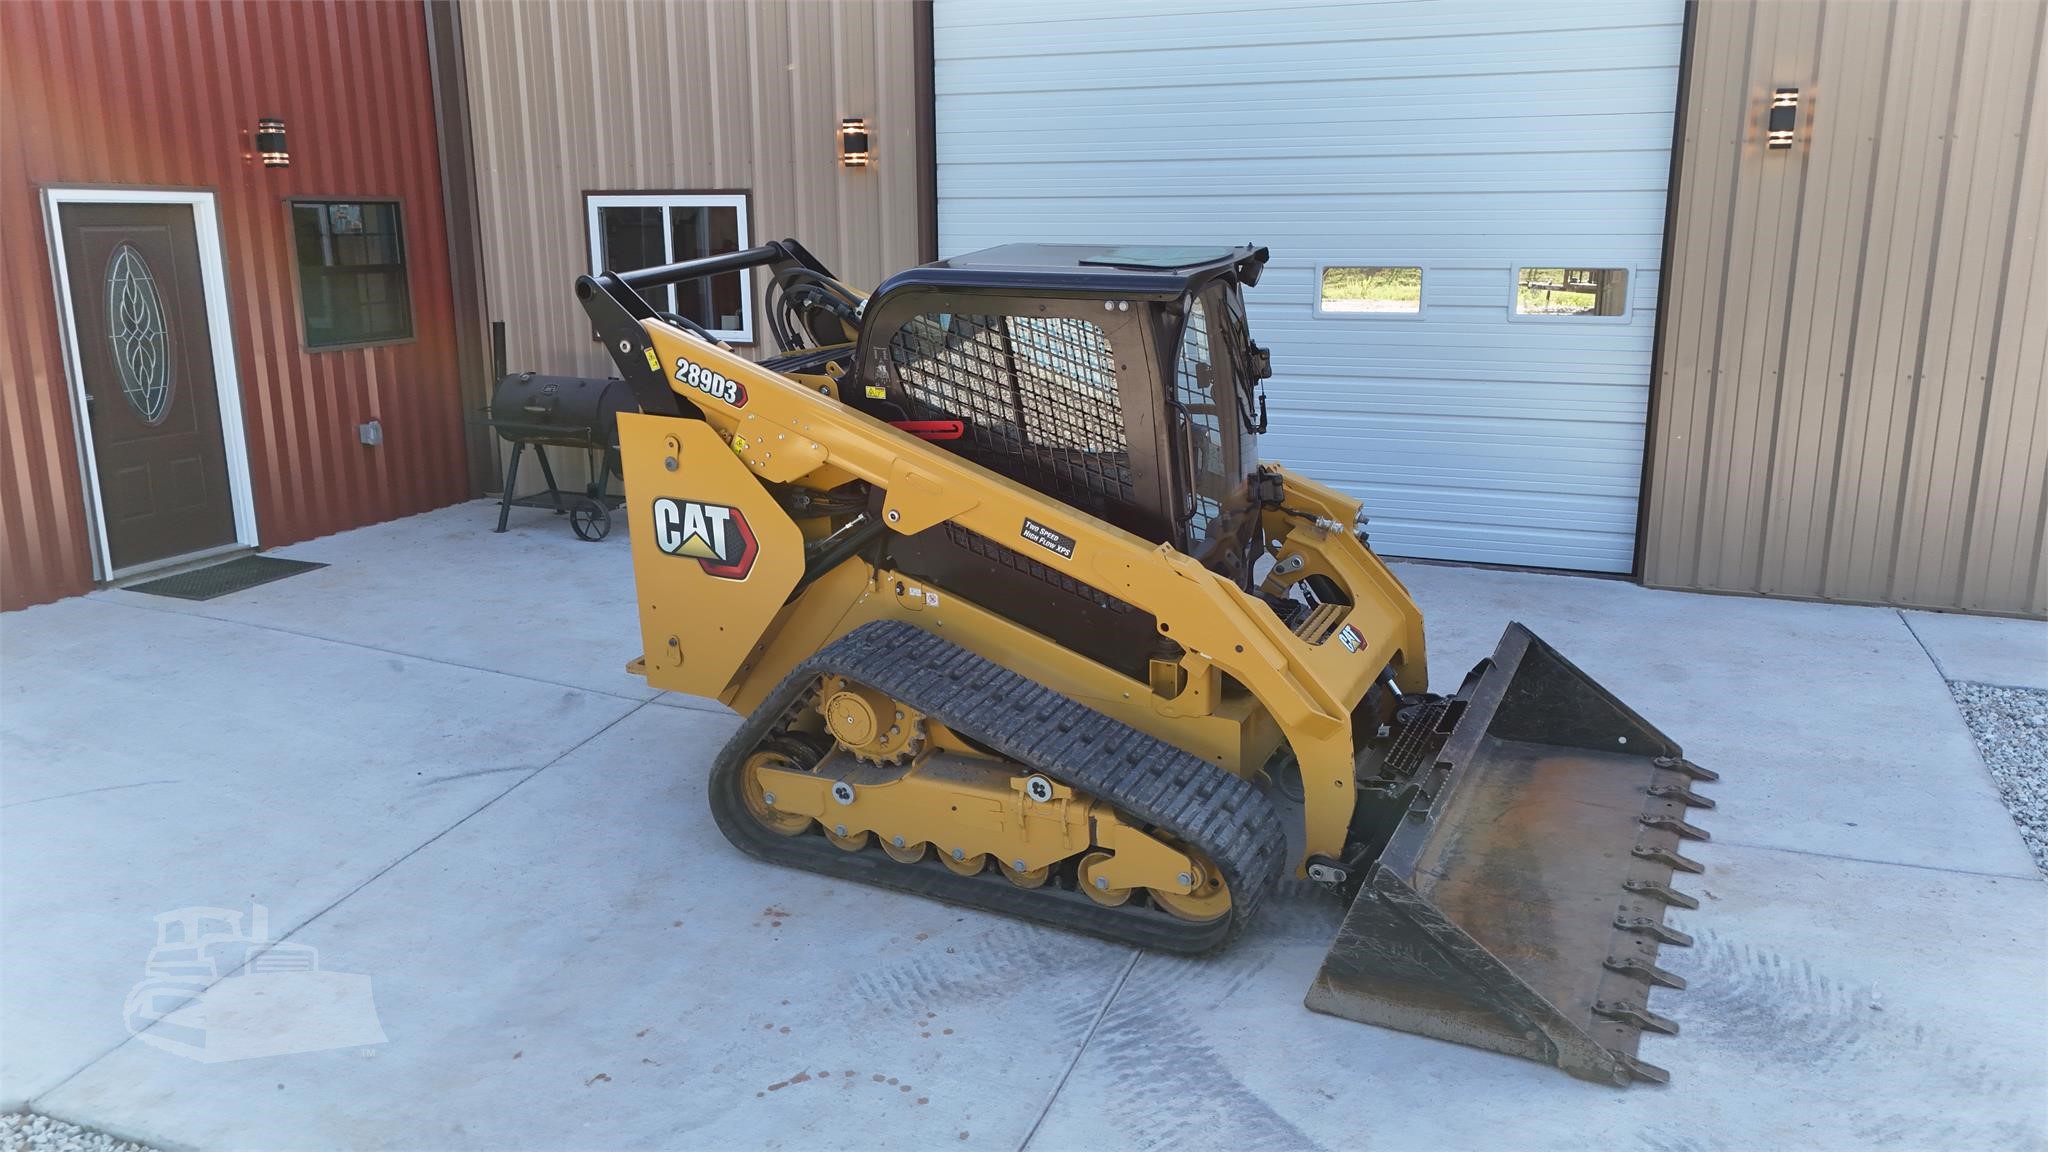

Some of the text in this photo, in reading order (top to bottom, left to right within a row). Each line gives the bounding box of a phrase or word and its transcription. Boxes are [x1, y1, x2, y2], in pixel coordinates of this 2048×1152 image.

[676, 358, 738, 403] 289D3
[654, 499, 730, 560] CAT
[1056, 545, 1071, 556] XPS
[1339, 625, 1361, 652] CAT
